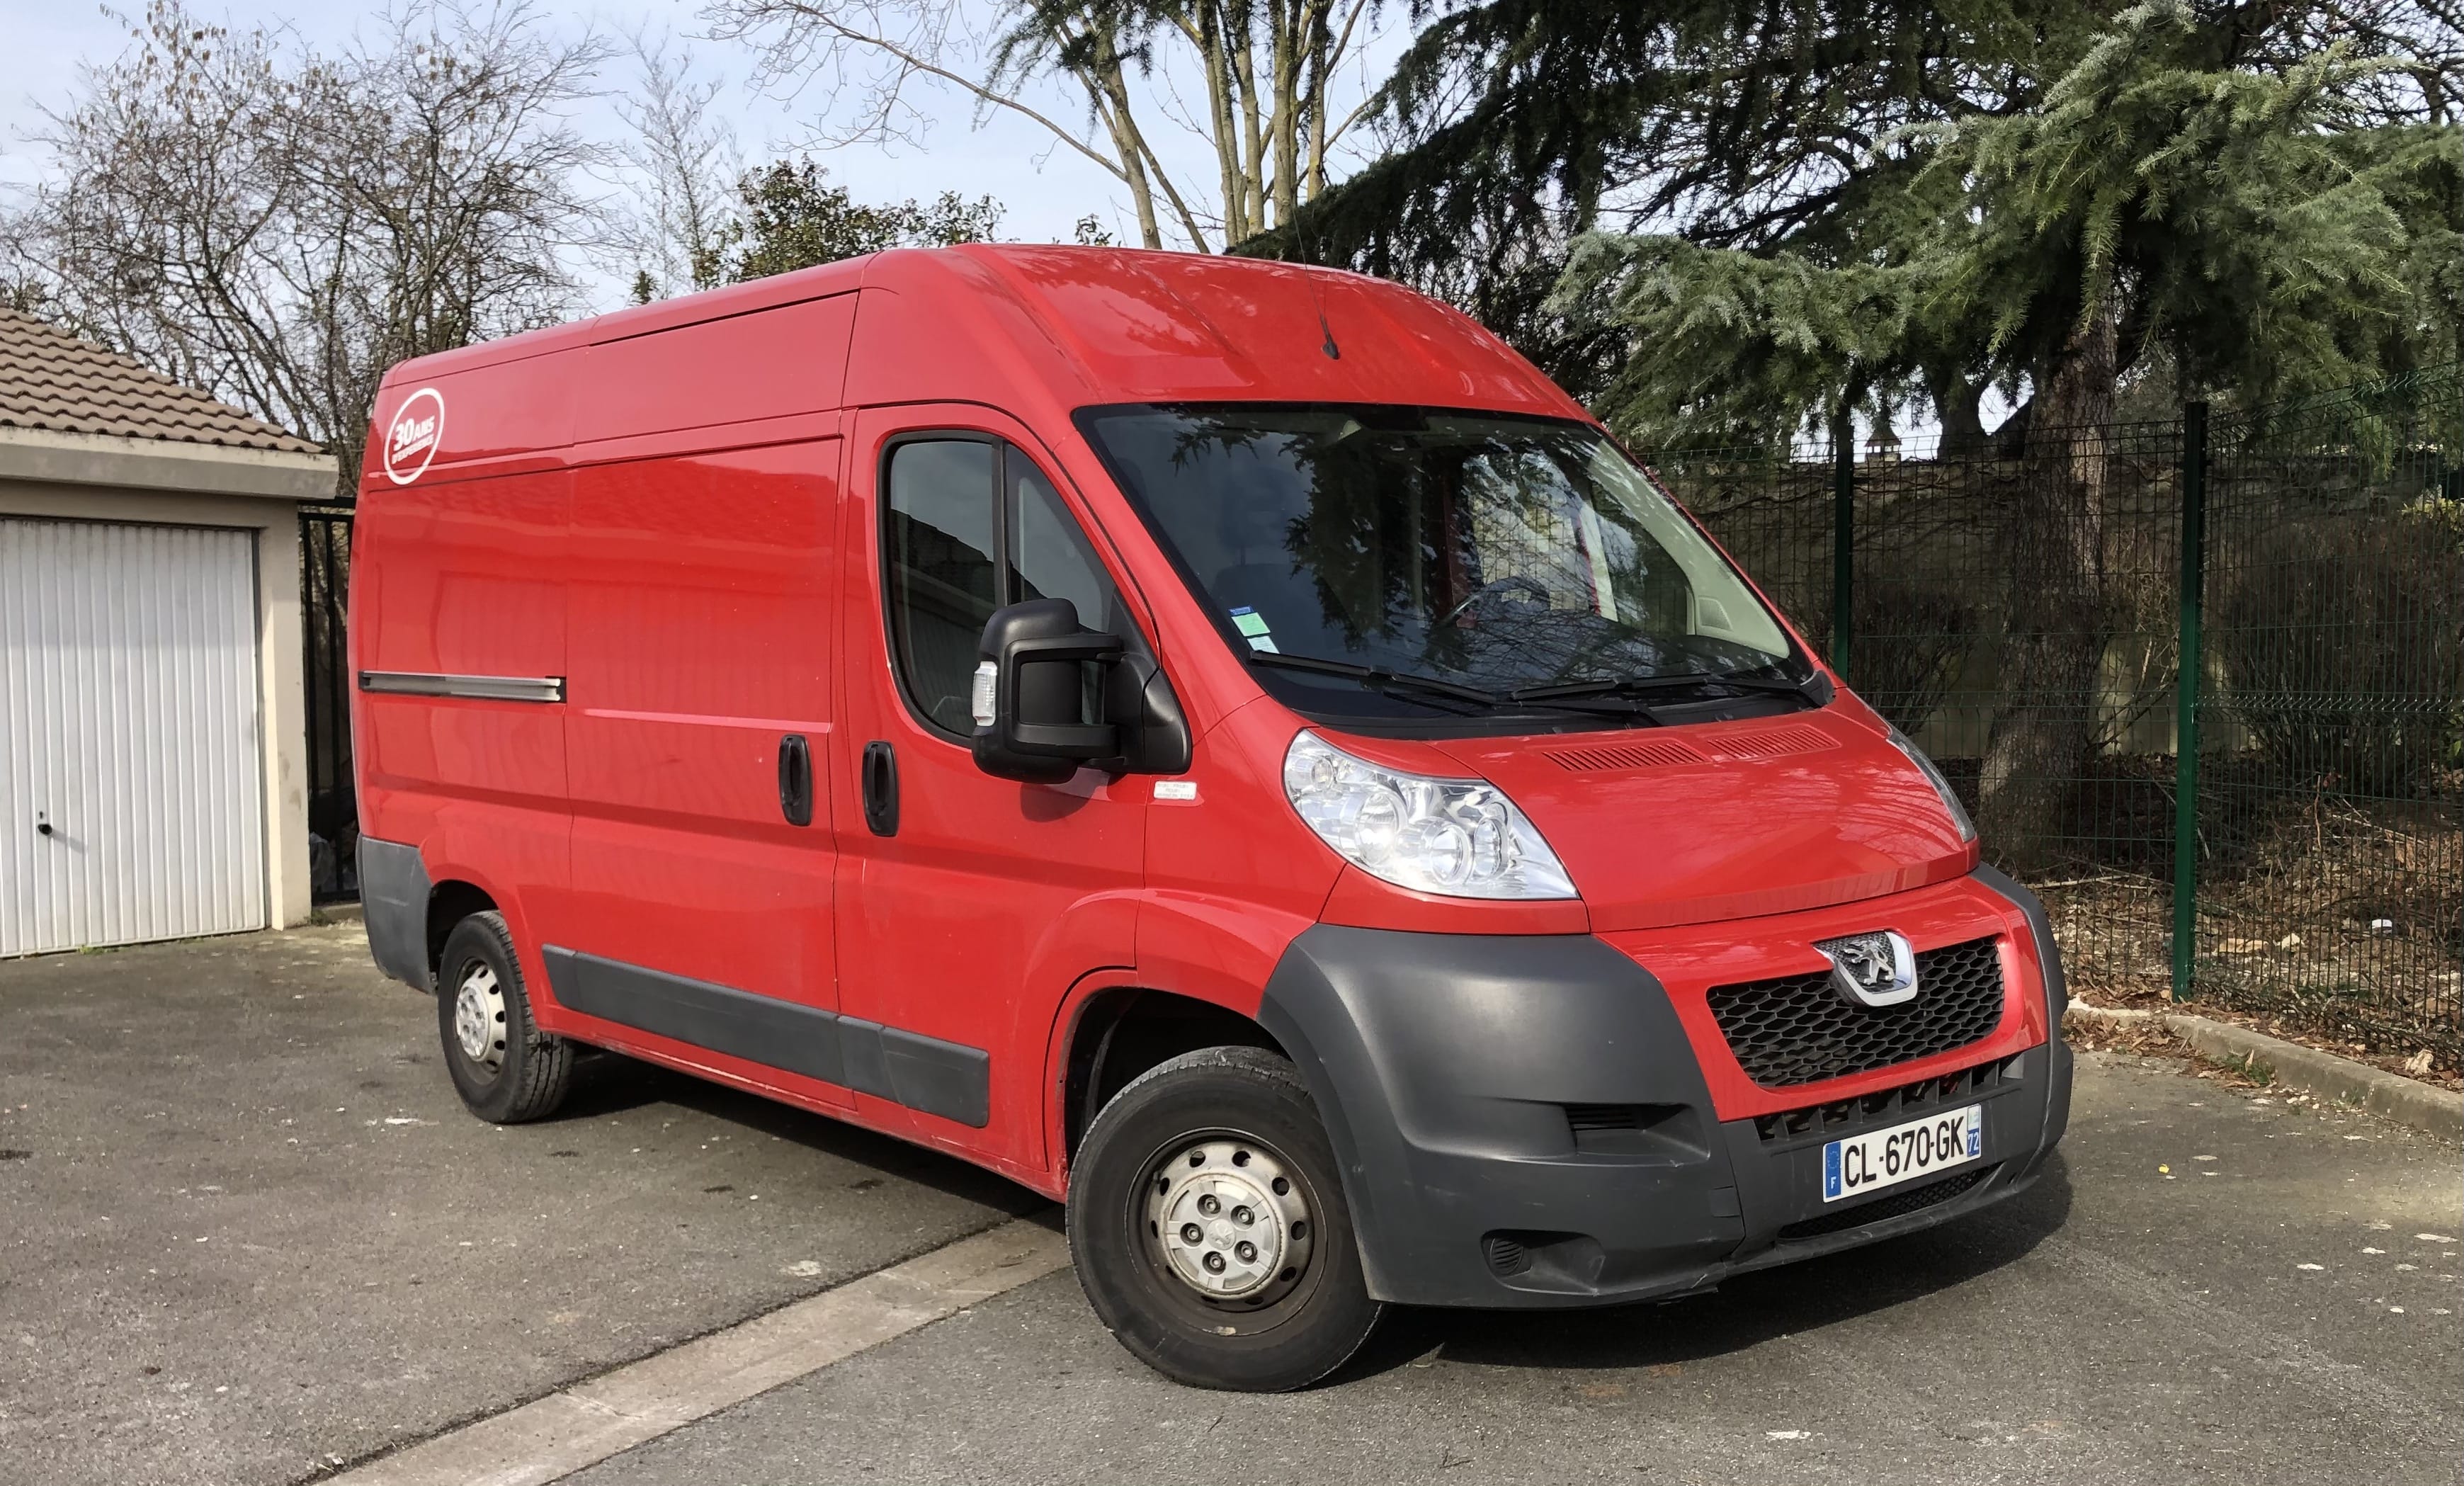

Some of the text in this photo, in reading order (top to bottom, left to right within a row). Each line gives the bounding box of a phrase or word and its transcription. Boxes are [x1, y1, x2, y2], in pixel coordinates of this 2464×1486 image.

[393, 415, 435, 451] 30 ANS
[1830, 1116, 1980, 1189] F CL-670-GK 72
